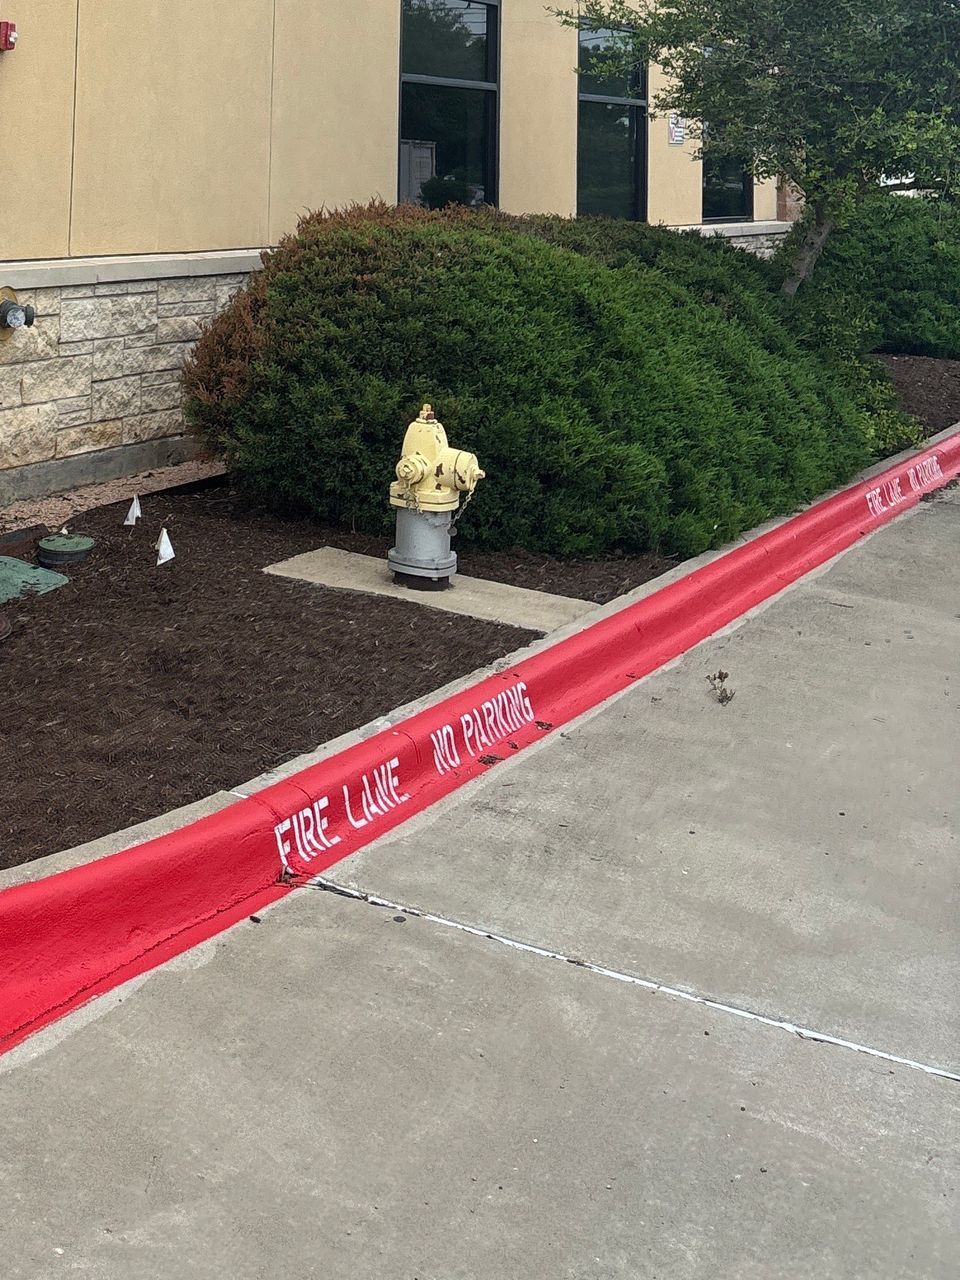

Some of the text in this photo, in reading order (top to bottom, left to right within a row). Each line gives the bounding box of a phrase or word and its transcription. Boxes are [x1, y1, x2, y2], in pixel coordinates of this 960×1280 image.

[274, 681, 535, 874] FIRE LANE NO PARKING
